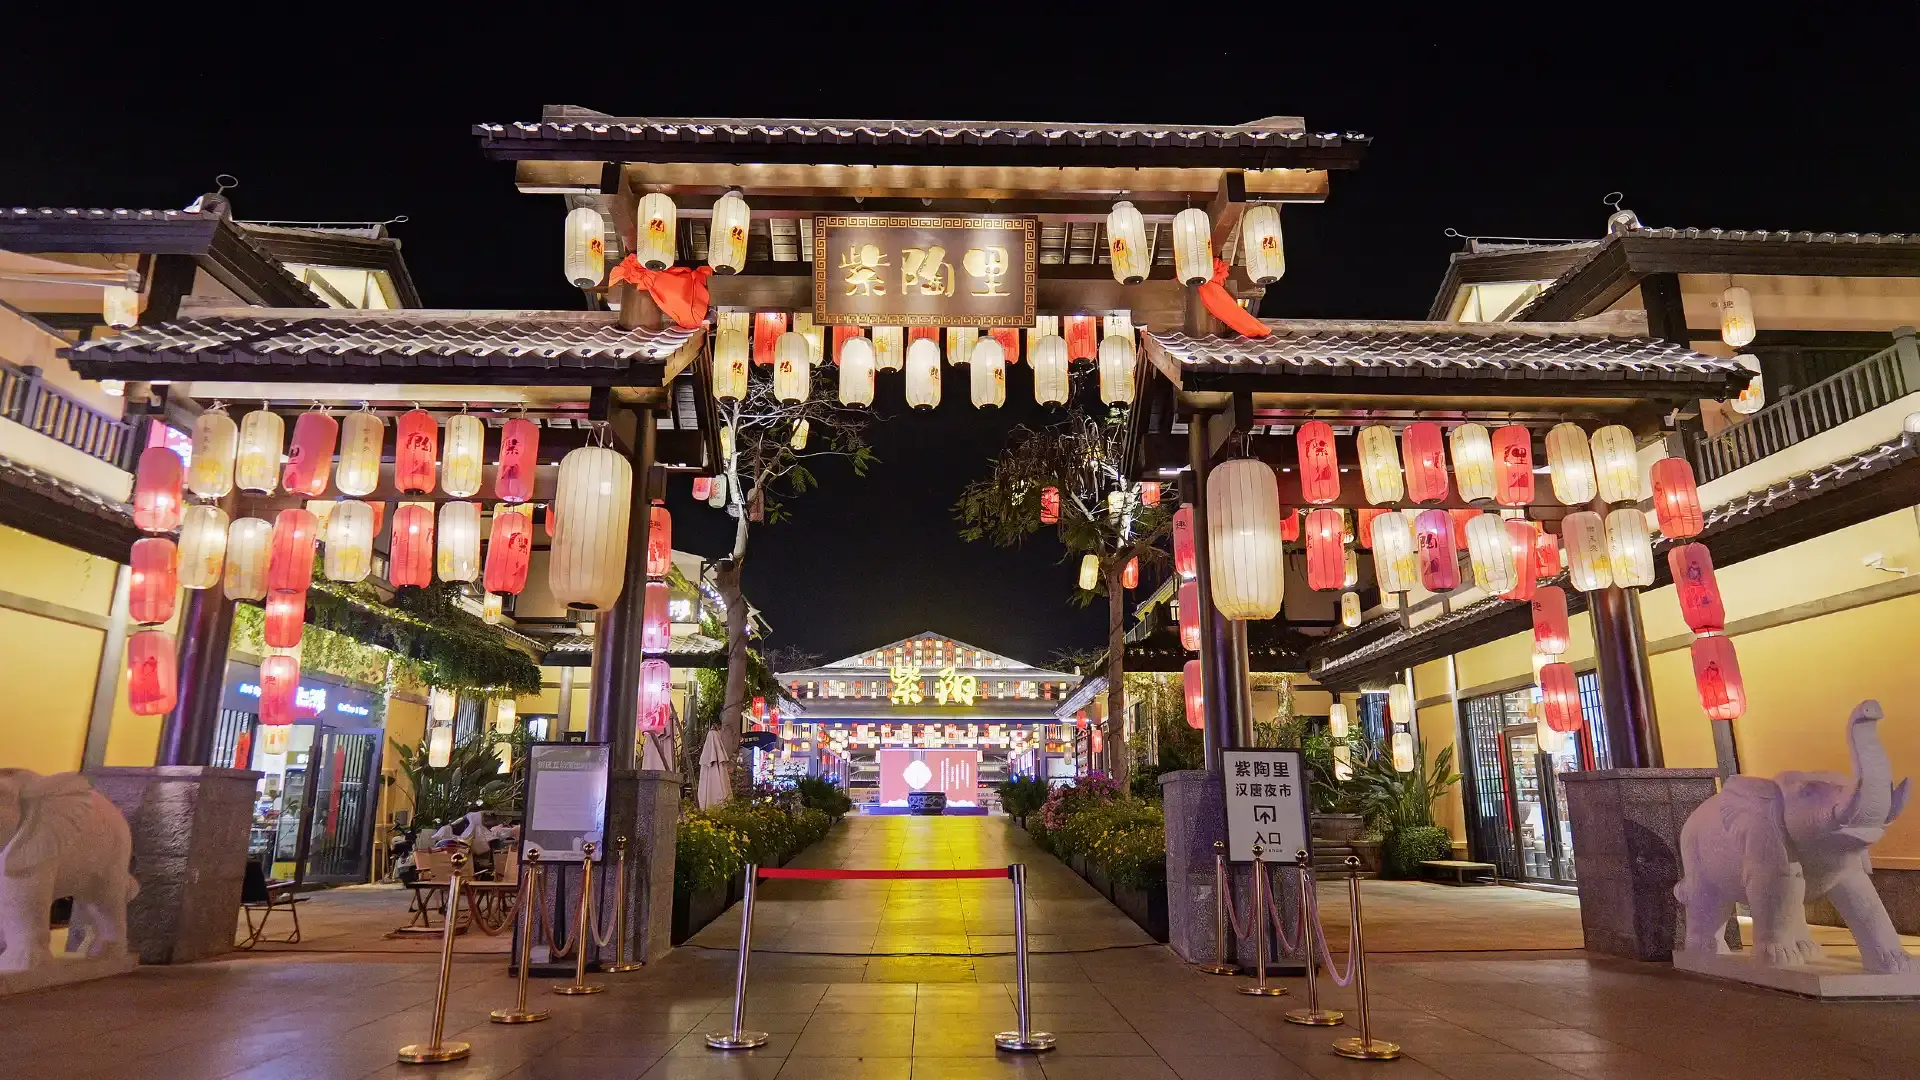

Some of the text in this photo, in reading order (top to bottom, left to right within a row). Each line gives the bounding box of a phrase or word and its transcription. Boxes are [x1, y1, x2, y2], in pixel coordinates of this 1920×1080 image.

[838, 244, 1011, 298] 紫陶里
[1234, 761, 1290, 778] 紫陶里
[1235, 782, 1292, 798] 汉唐夜市
[1253, 831, 1282, 845] 入口
